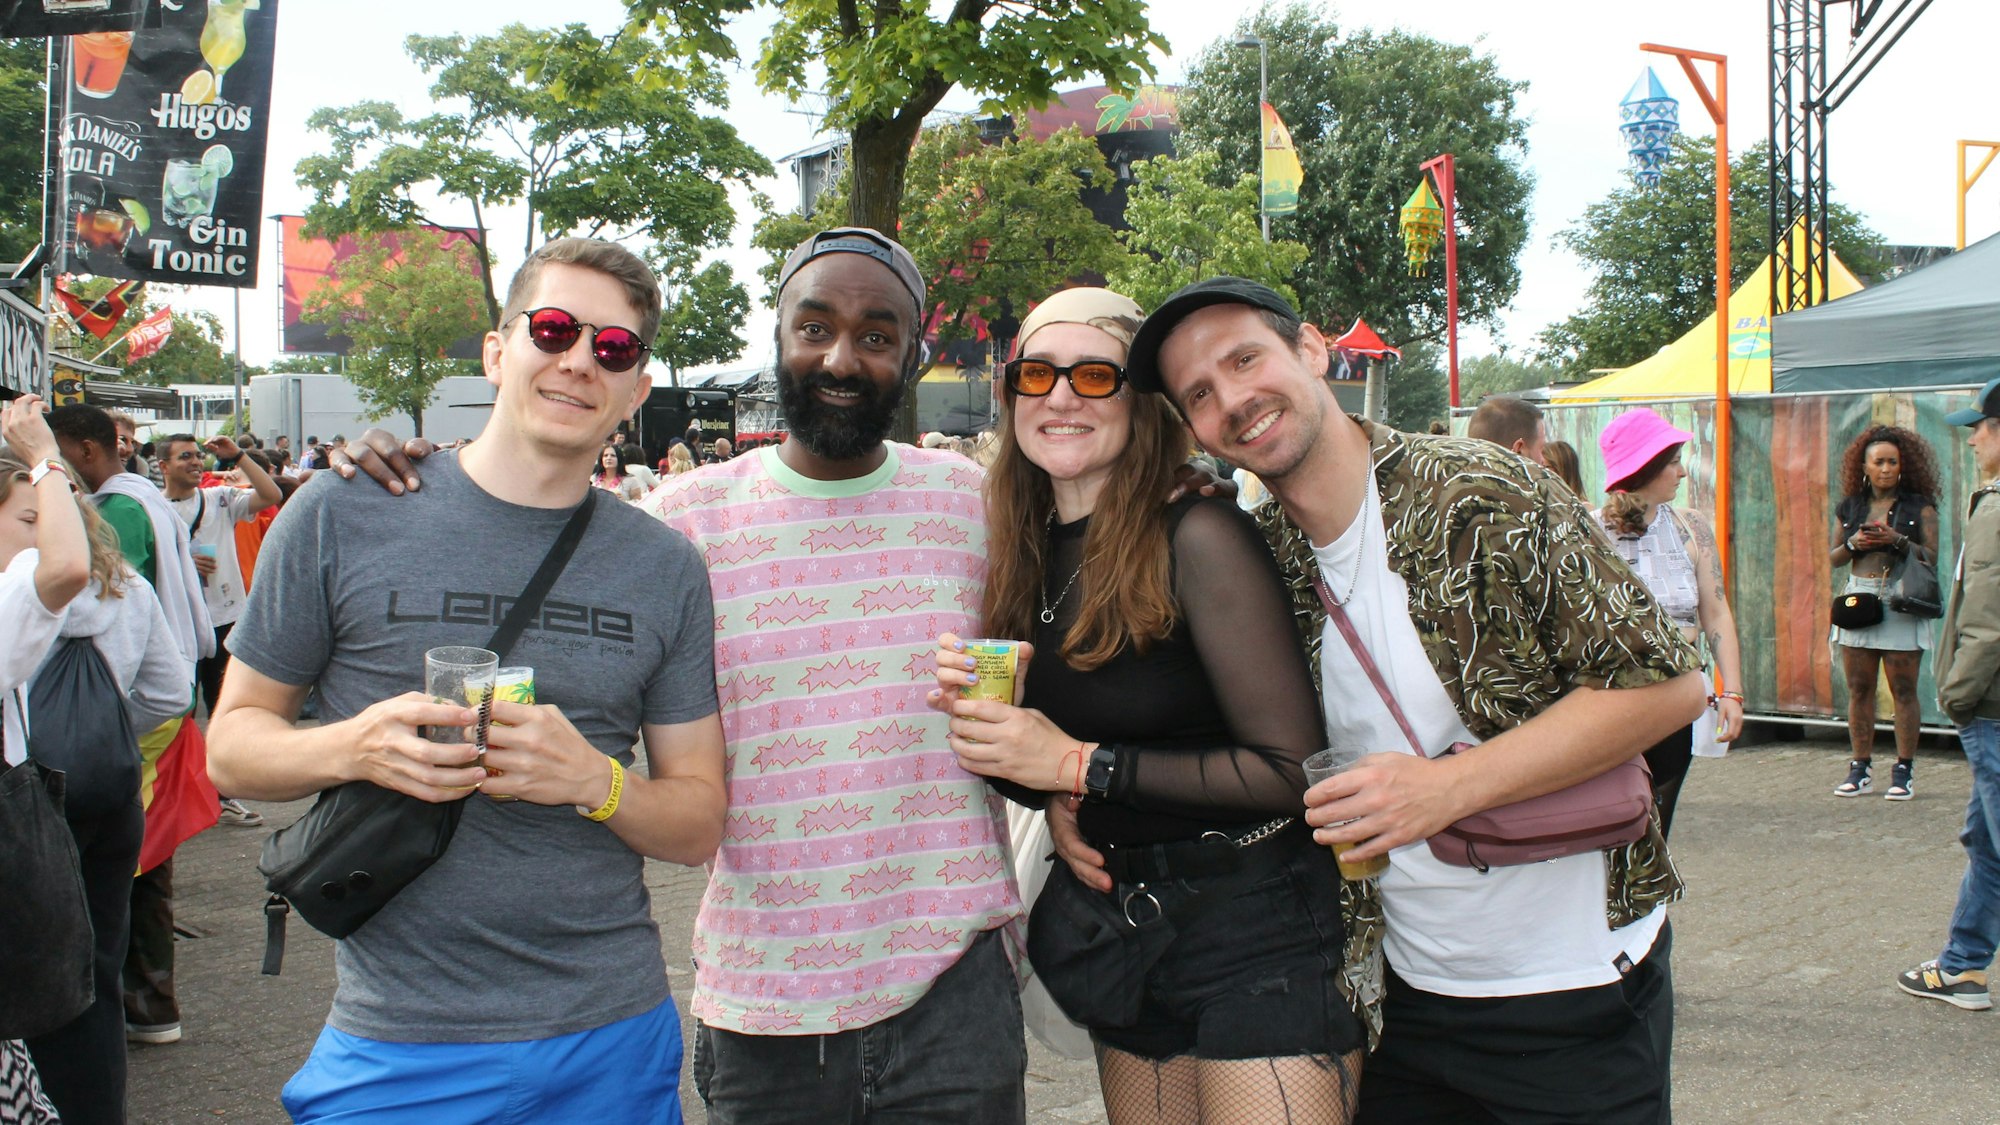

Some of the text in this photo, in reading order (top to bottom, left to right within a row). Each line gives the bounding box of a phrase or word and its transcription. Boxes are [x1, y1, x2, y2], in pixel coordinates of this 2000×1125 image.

[151, 93, 252, 140] Hugos
[79, 117, 143, 162] DANIEL'S
[189, 215, 248, 247] Gin
[148, 239, 247, 276] Tonic
[702, 419, 729, 430] Warsteiner
[923, 570, 961, 593] obey
[562, 640, 593, 658] your
[601, 644, 635, 657] passion
